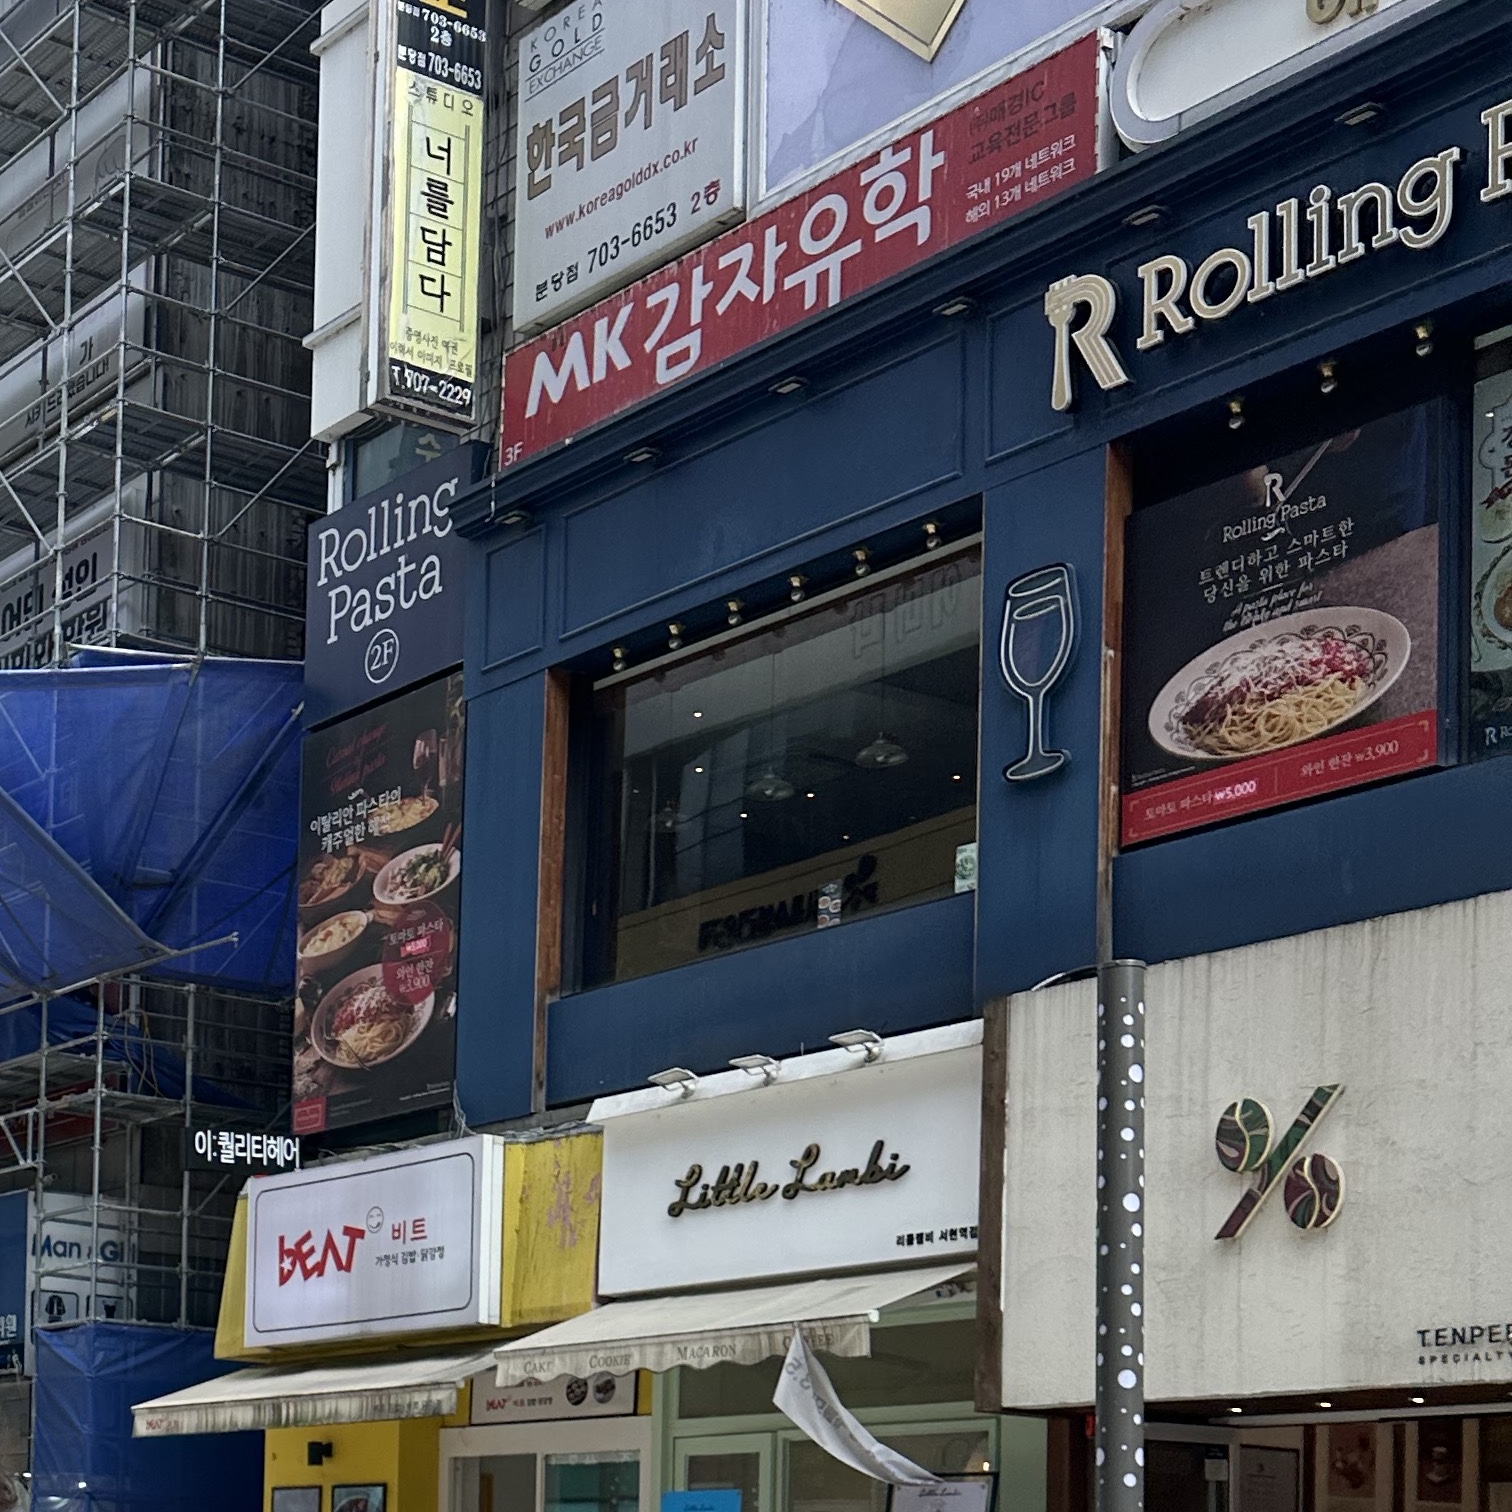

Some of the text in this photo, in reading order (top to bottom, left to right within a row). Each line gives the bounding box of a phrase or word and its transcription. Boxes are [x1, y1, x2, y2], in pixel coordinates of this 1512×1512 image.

[421, 8, 487, 43] 703-6653
[529, 13, 603, 74] GOLD
[427, 52, 483, 91] 703-6653
[528, 35, 603, 95] EXCHANGE
[526, 12, 726, 201] 한국금거래소
[965, 157, 1077, 223] 해외 13개 네트워크
[966, 134, 1077, 200] 국내 19개 네트워크
[418, 136, 455, 314] 너를담다
[535, 179, 721, 302] 분당점 703-6653 2층
[1137, 146, 1461, 351] Rolling
[504, 441, 524, 468] 3F
[316, 477, 459, 588] Rolling
[1222, 494, 1328, 544] Rolling Pasta
[1199, 517, 1356, 586] 트렌디하고 스마트한
[1203, 540, 1349, 605] 당신을 위한 파스타
[326, 554, 444, 645] Pasta
[310, 785, 403, 837] 이탈리안 파스타의
[321, 821, 366, 854] 캐주얼한
[195, 1130, 301, 1169] 이:퀄리티헤어
[667, 1160, 780, 1218] Little
[31, 1233, 82, 1260] Man
[375, 1252, 399, 1267] 가정식
[391, 1217, 428, 1245] 비트
